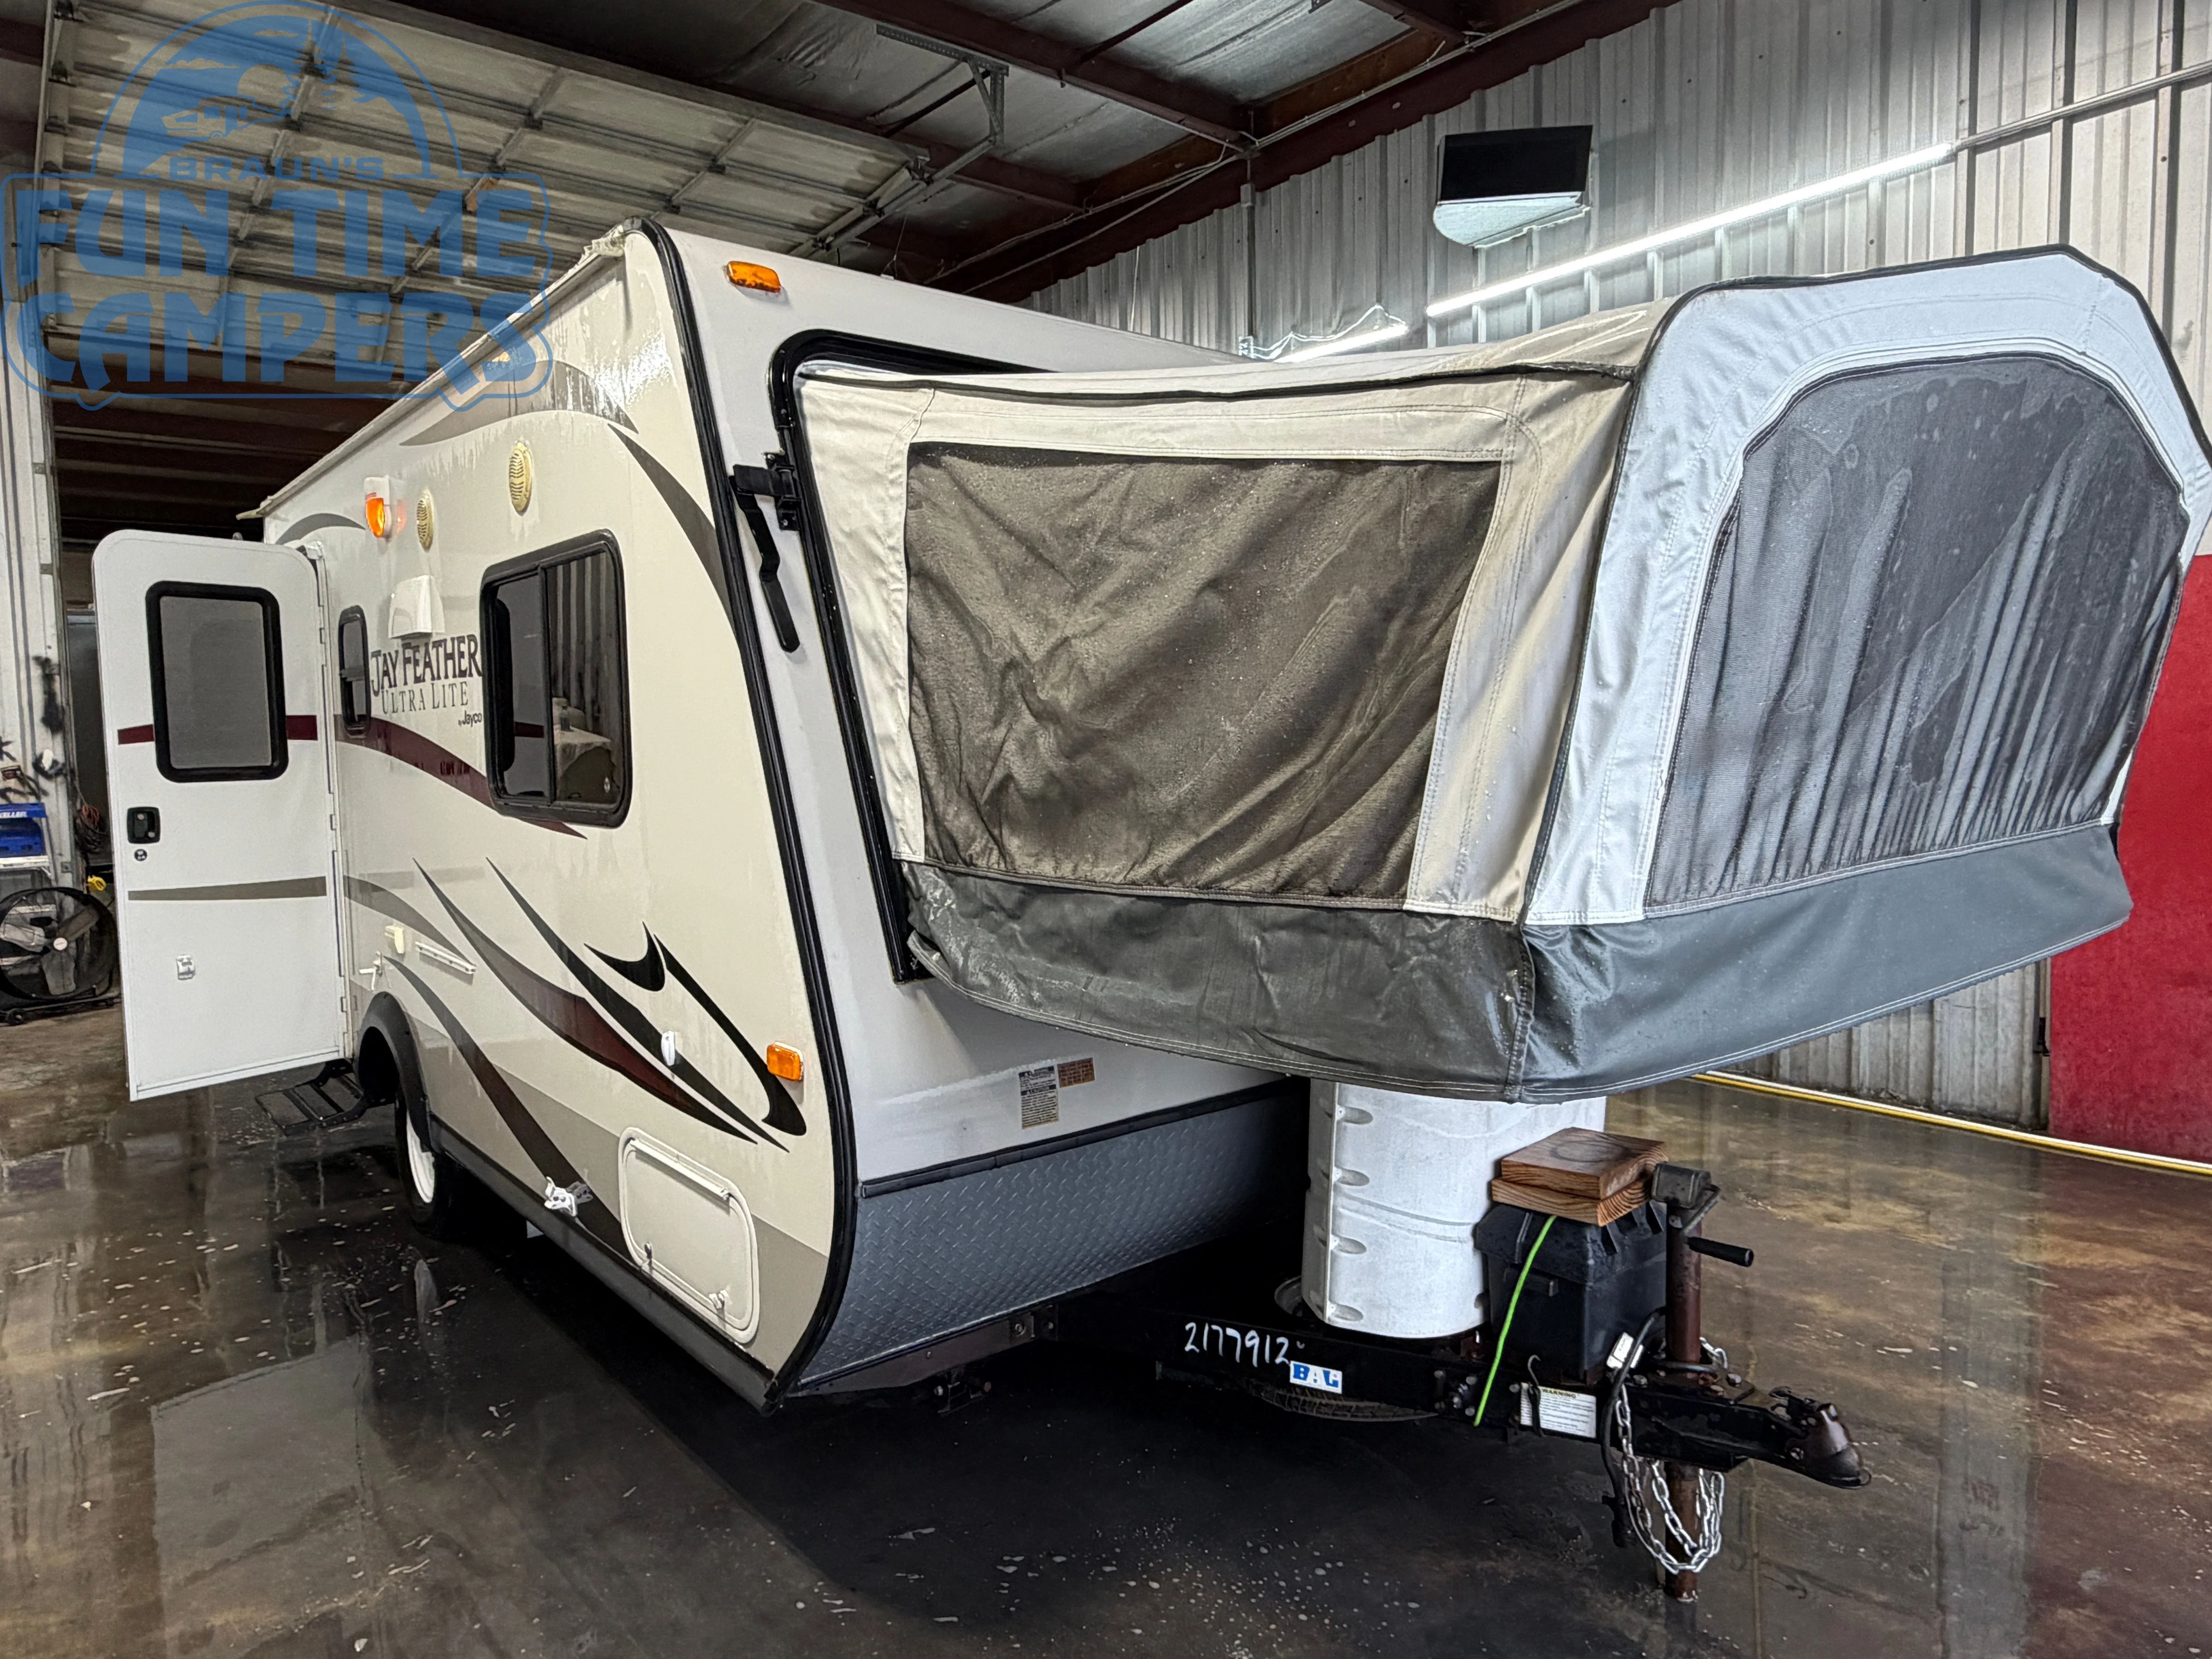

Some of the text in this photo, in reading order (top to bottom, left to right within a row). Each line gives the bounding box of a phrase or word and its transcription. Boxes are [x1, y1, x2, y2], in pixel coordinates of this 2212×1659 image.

[371, 634, 483, 697] JAY FEATHER
[381, 681, 468, 714] ULTRA LITE
[1184, 1322, 1290, 1368] 2177912
